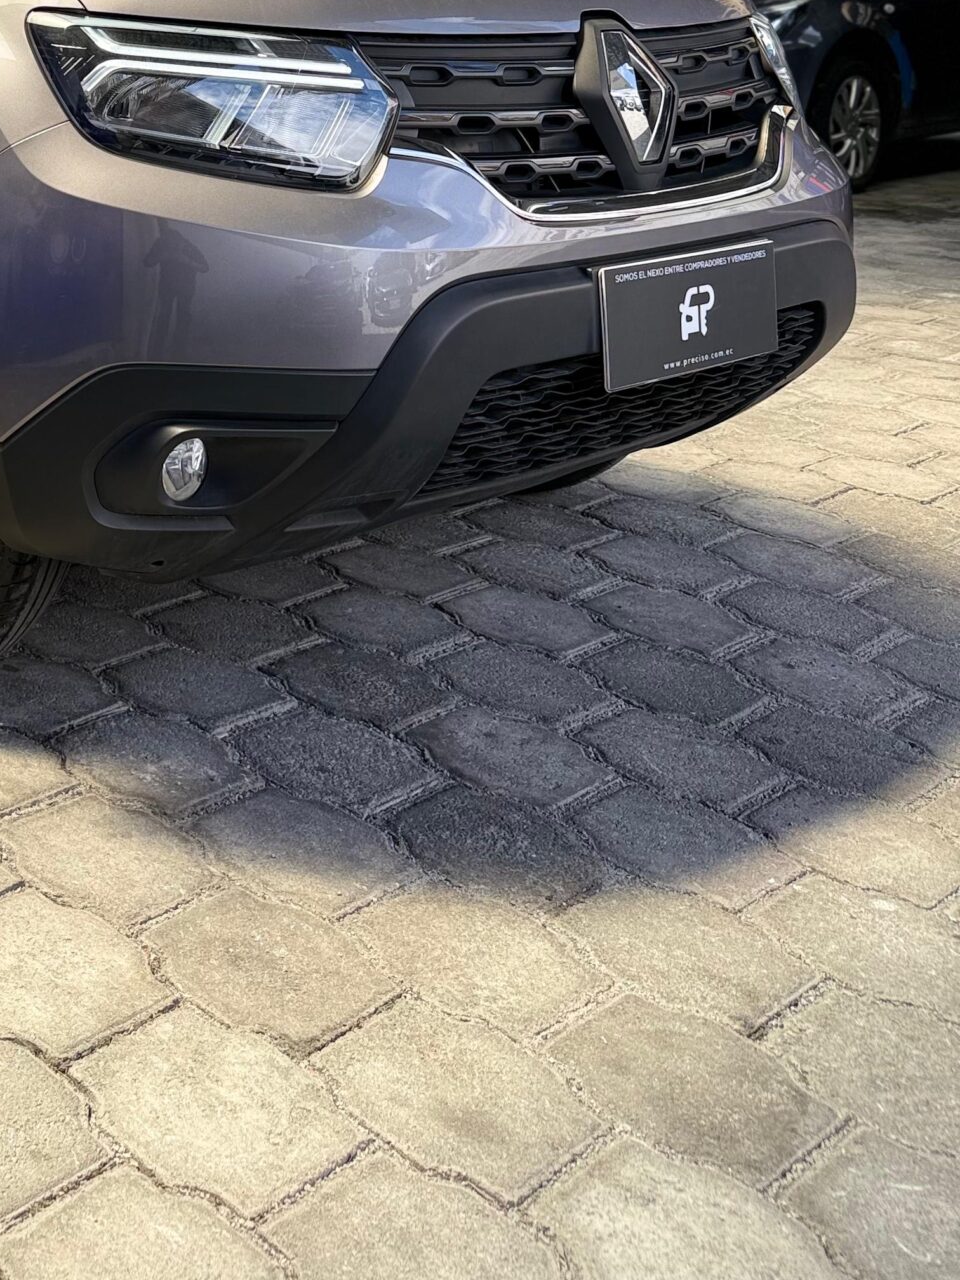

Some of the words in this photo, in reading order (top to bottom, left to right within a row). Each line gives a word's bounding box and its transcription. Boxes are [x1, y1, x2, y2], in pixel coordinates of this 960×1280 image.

[614, 270, 638, 283] SOMOS
[639, 270, 647, 280] EL
[647, 267, 664, 278] NEXO
[664, 264, 684, 275] ENTRE
[684, 257, 727, 272] COMPRADORES
[727, 256, 732, 264] Y
[732, 249, 767, 263] VENDEDORES
[663, 347, 734, 370] www.preciso.com.ec
